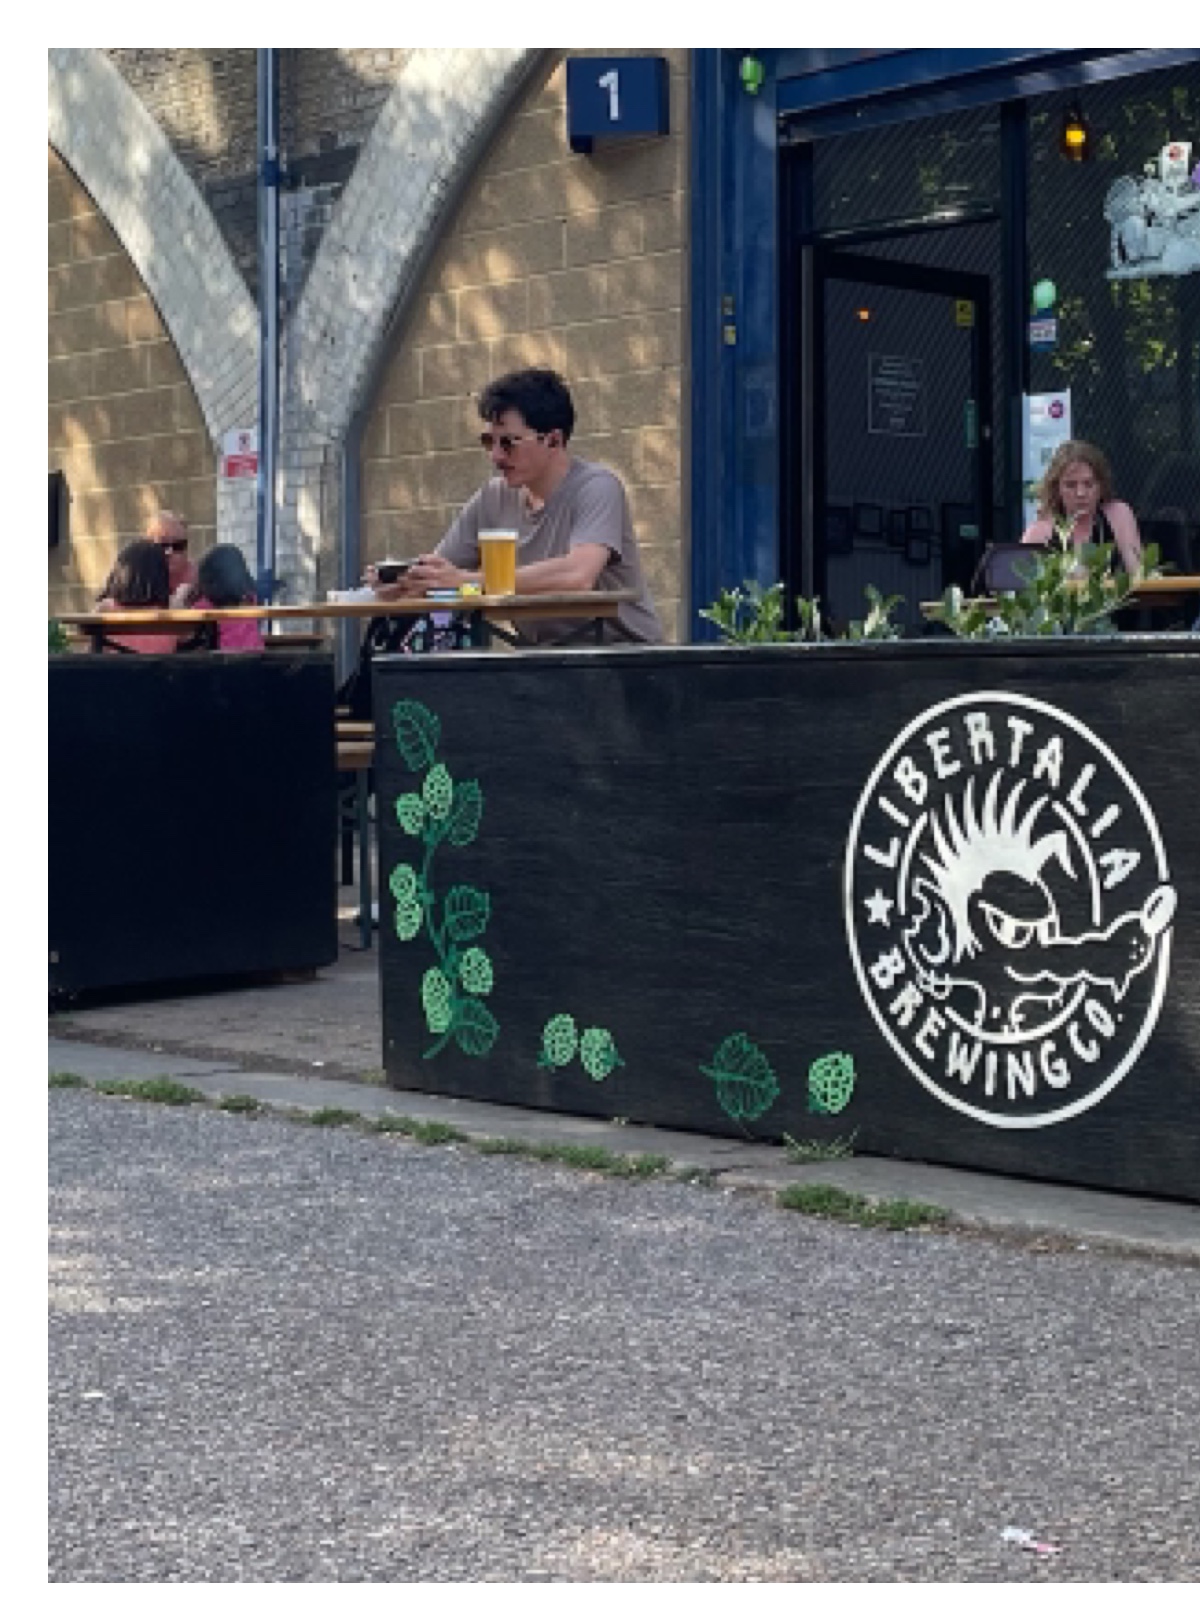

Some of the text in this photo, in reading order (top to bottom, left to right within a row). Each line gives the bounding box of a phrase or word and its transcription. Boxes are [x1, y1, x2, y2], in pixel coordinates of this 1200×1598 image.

[597, 68, 619, 121] 1
[863, 711, 1142, 890] LIBERTALIA
[868, 945, 1125, 1100] BREWING CO.
